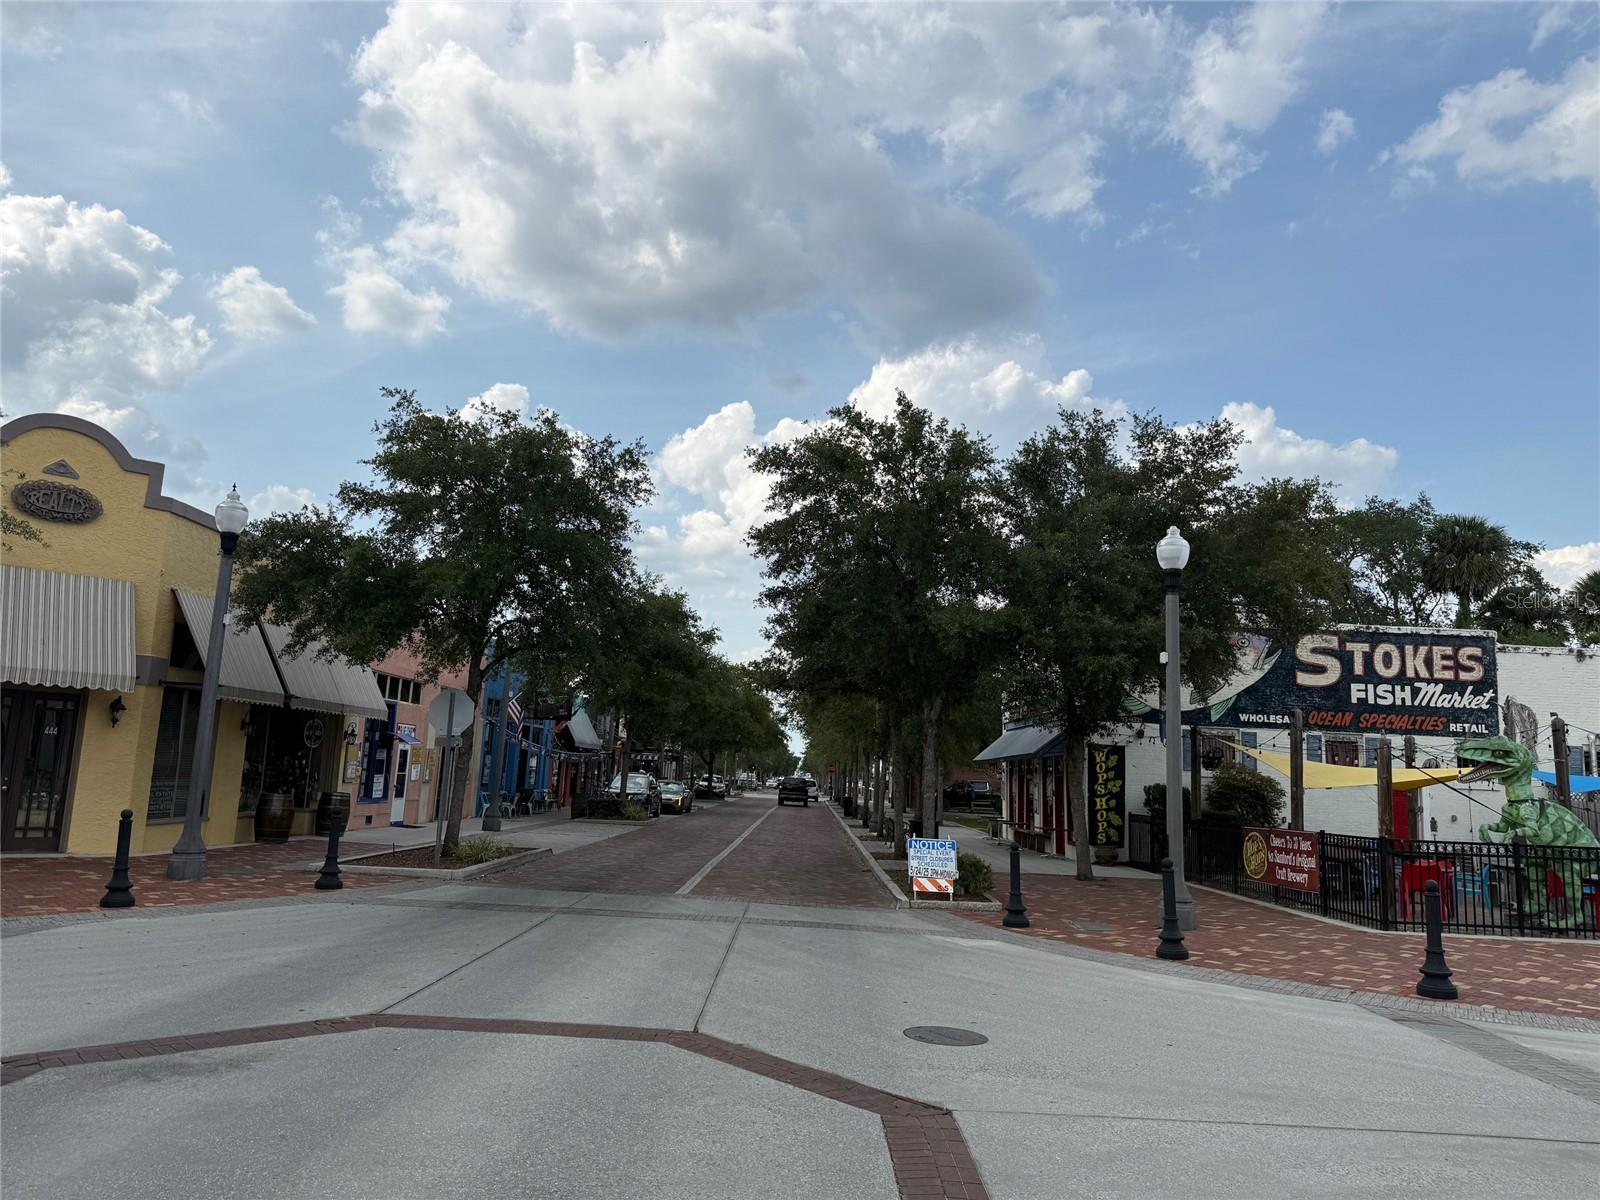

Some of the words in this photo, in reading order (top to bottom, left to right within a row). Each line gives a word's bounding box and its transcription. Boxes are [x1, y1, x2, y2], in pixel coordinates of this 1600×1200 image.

[27, 490, 89, 513] REALTY
[1295, 633, 1485, 688] STOKES
[1350, 683, 1412, 706] FISH
[1413, 682, 1496, 710] Market
[1238, 713, 1291, 724] WHOLESA
[1307, 710, 1353, 727] OCEAN
[1359, 713, 1447, 731] SPECIALTIES
[1449, 723, 1489, 734] RETAIL
[1094, 747, 1109, 795] WOP'S
[1094, 794, 1110, 844] HOPS
[911, 840, 953, 850] NOTICE
[1287, 868, 1308, 887] Brewery
